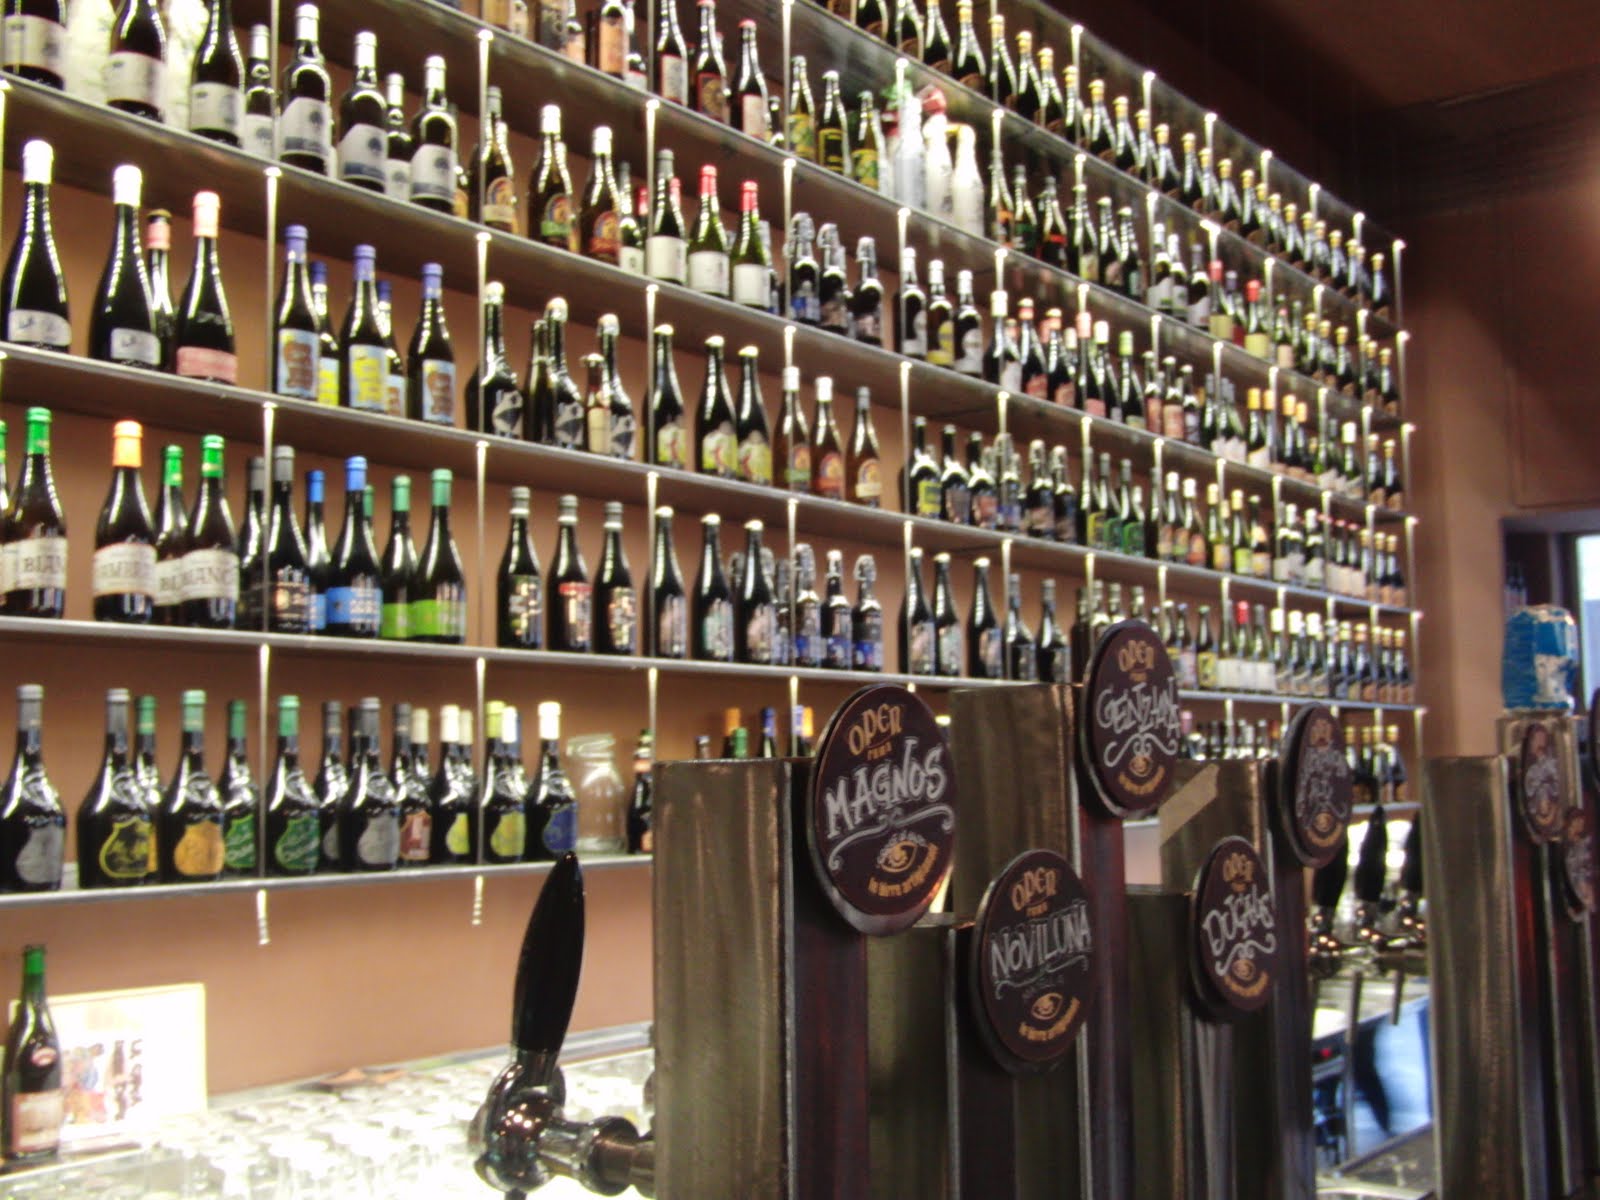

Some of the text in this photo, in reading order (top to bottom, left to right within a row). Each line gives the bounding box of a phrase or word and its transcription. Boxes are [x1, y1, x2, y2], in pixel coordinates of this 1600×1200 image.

[848, 703, 902, 756] OPEN
[1012, 866, 1057, 911] OPEN
[990, 901, 1092, 978] NOVILUNA
